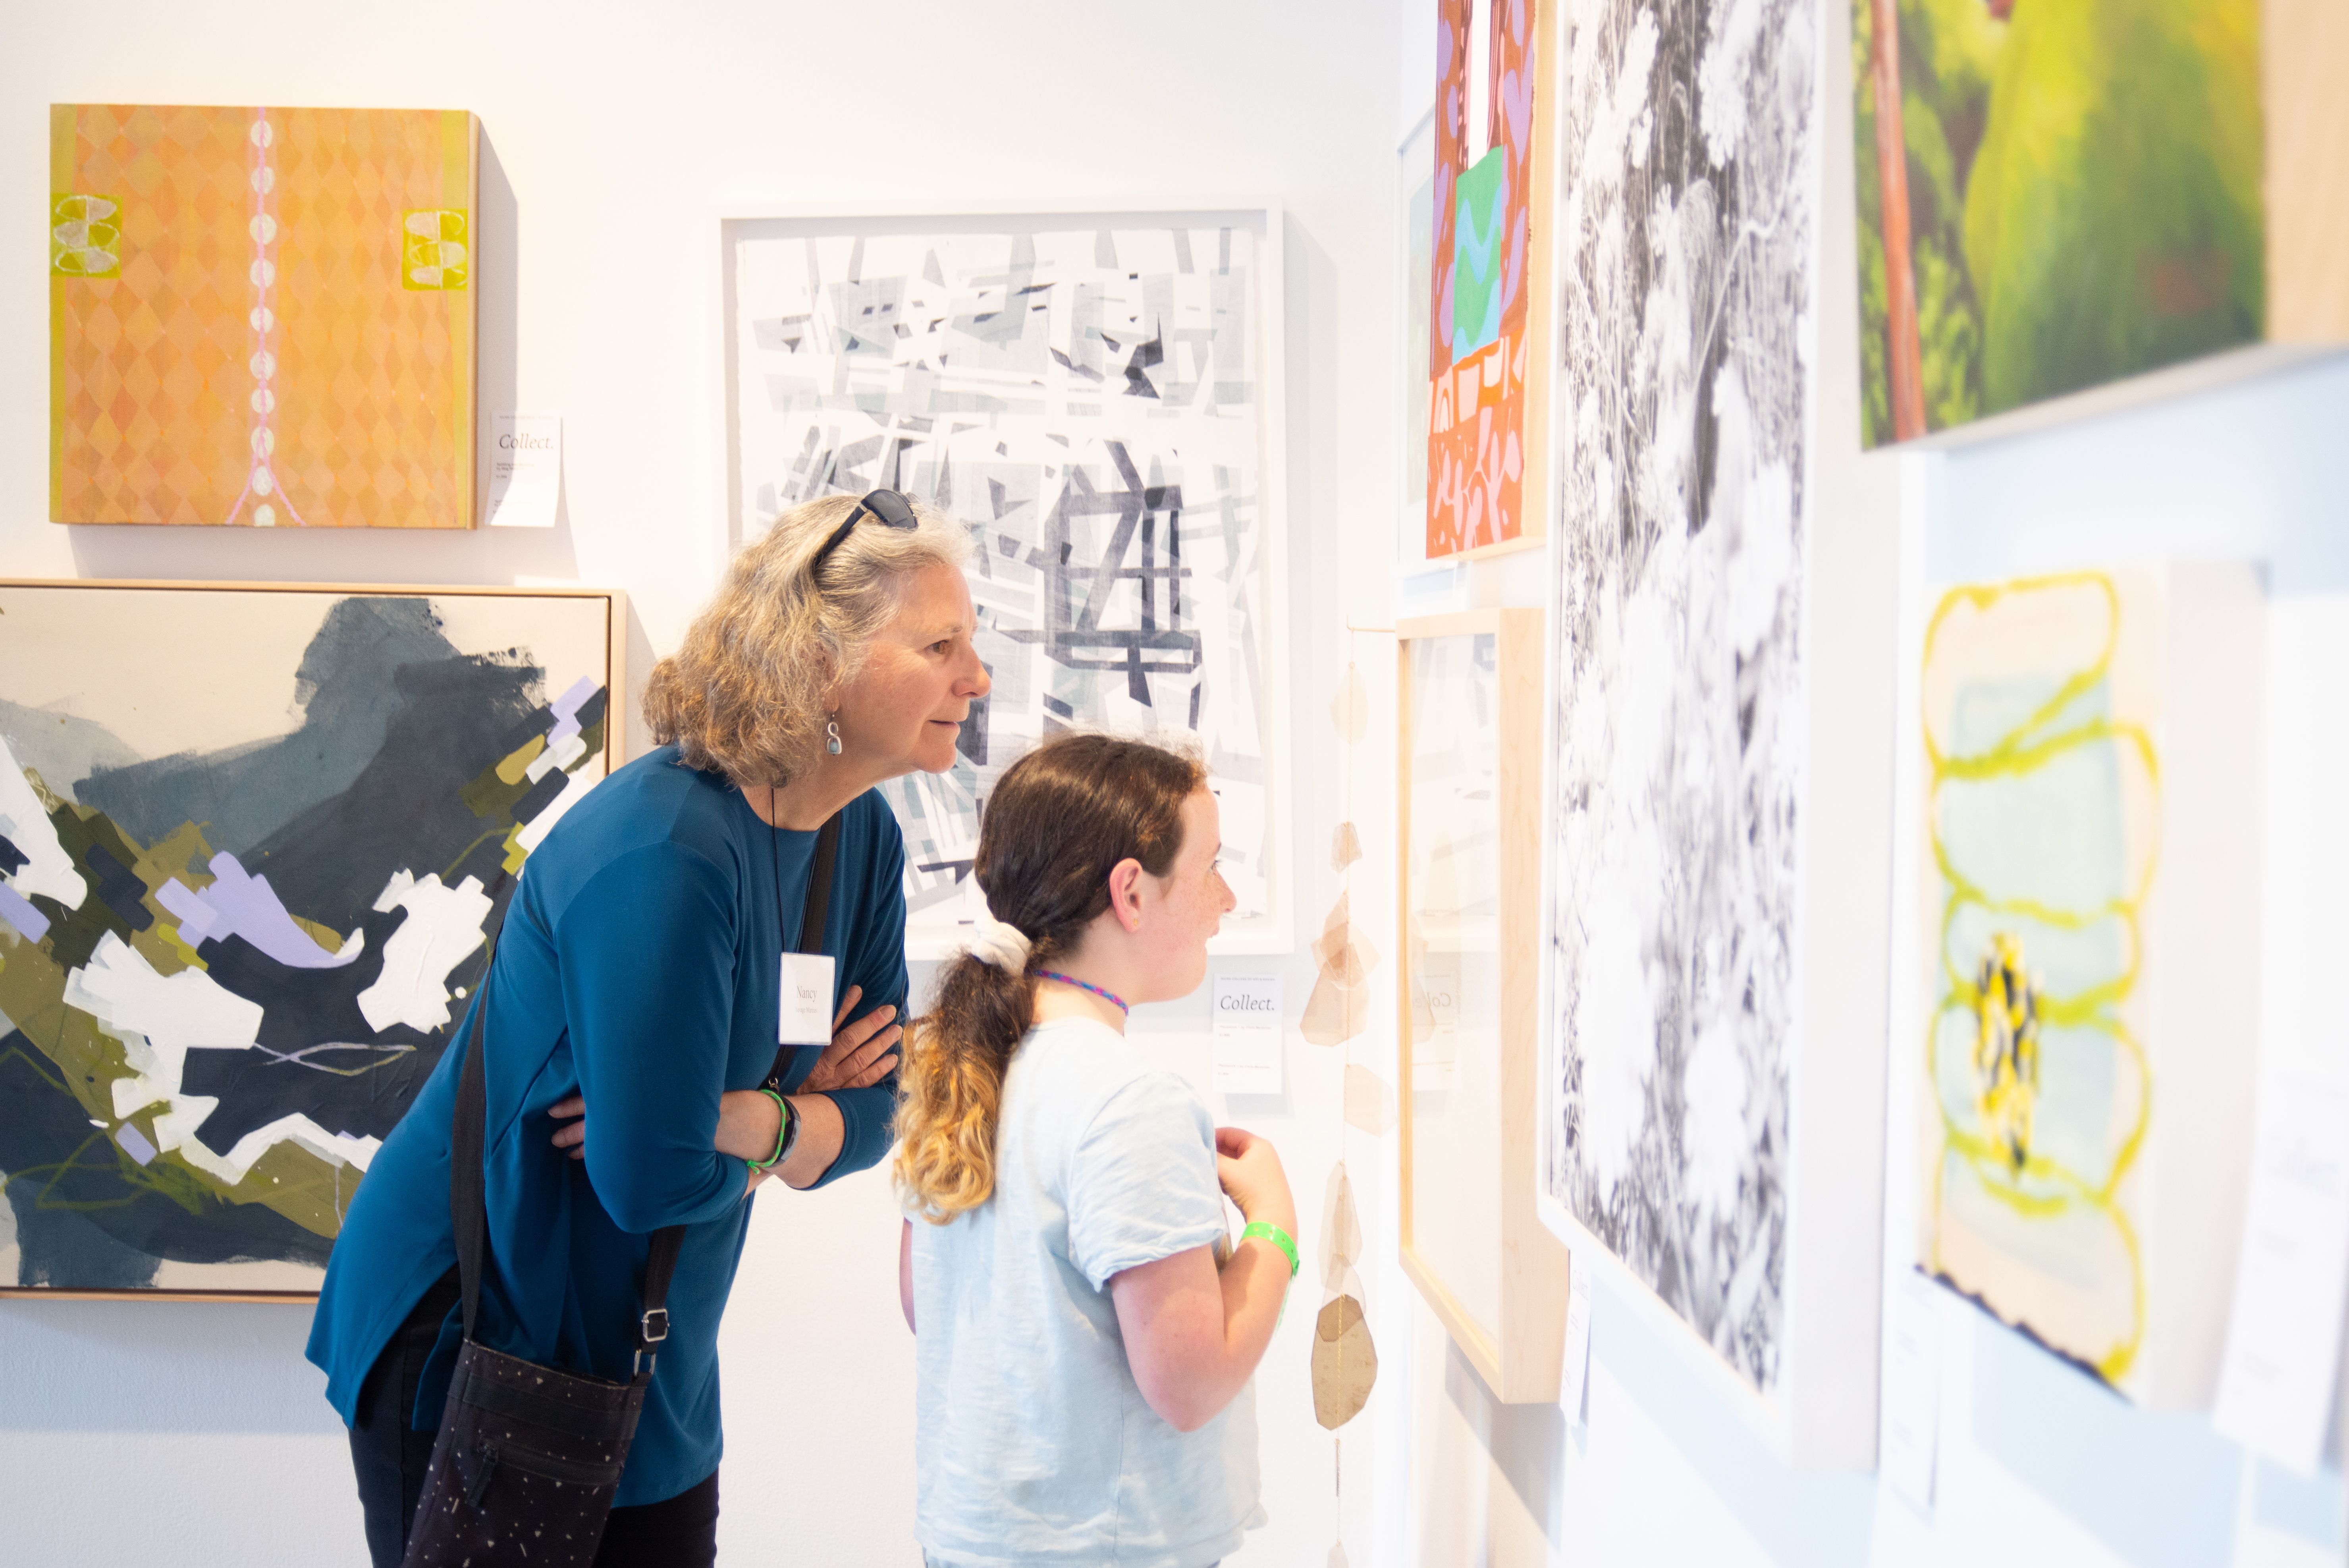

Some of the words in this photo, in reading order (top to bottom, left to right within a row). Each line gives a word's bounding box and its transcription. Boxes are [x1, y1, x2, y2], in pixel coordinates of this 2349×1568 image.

[499, 433, 553, 449] Collect.
[796, 985, 818, 1003] Nancy
[1221, 995, 1274, 1011] Collect.
